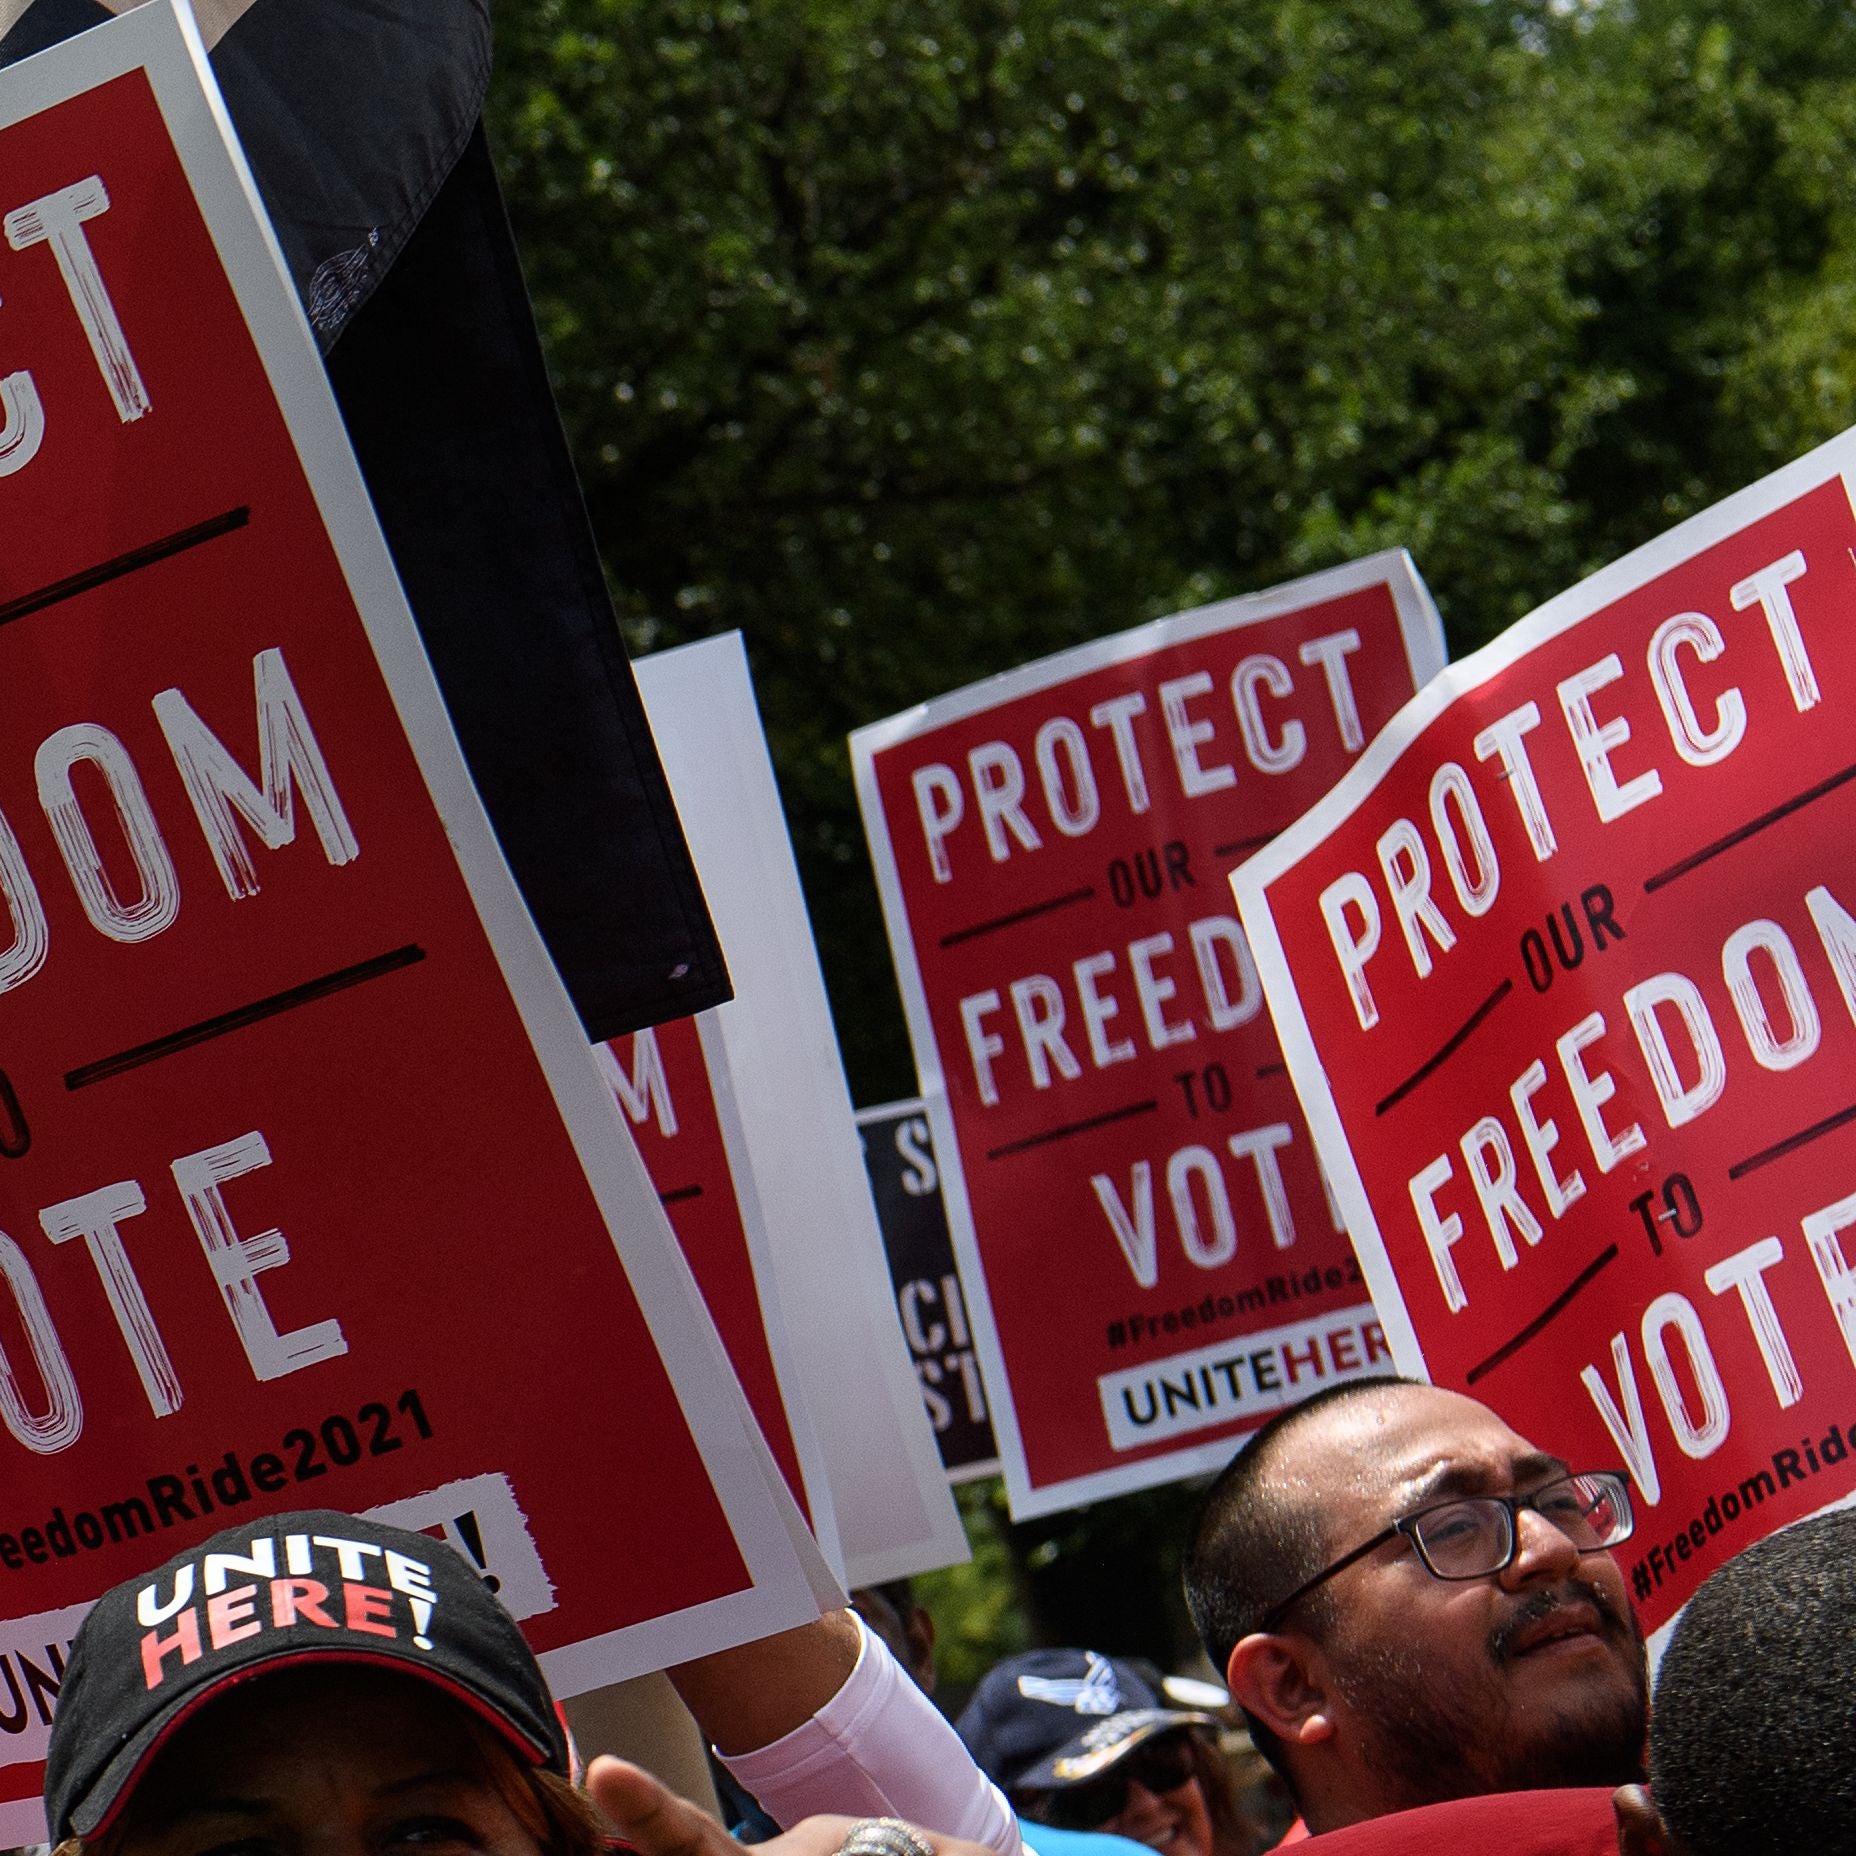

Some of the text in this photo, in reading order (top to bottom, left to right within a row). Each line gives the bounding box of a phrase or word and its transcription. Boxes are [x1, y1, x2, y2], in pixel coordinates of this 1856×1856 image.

[910, 628, 1367, 885] PROTECT
[1318, 549, 1824, 1032] PROTECT
[1106, 837, 1198, 910] OUR
[1518, 883, 1626, 995] OUR
[958, 913, 1263, 1108] FREED
[1175, 1060, 1234, 1120] TO
[1091, 1123, 1346, 1290] VOT
[1628, 1171, 1704, 1257] TO
[1106, 1254, 1363, 1350] #FreedomRide2
[1121, 1320, 1392, 1427] UNITEHER
[136, 1534, 438, 1628] UNITE
[139, 1578, 437, 1691] HERE!
